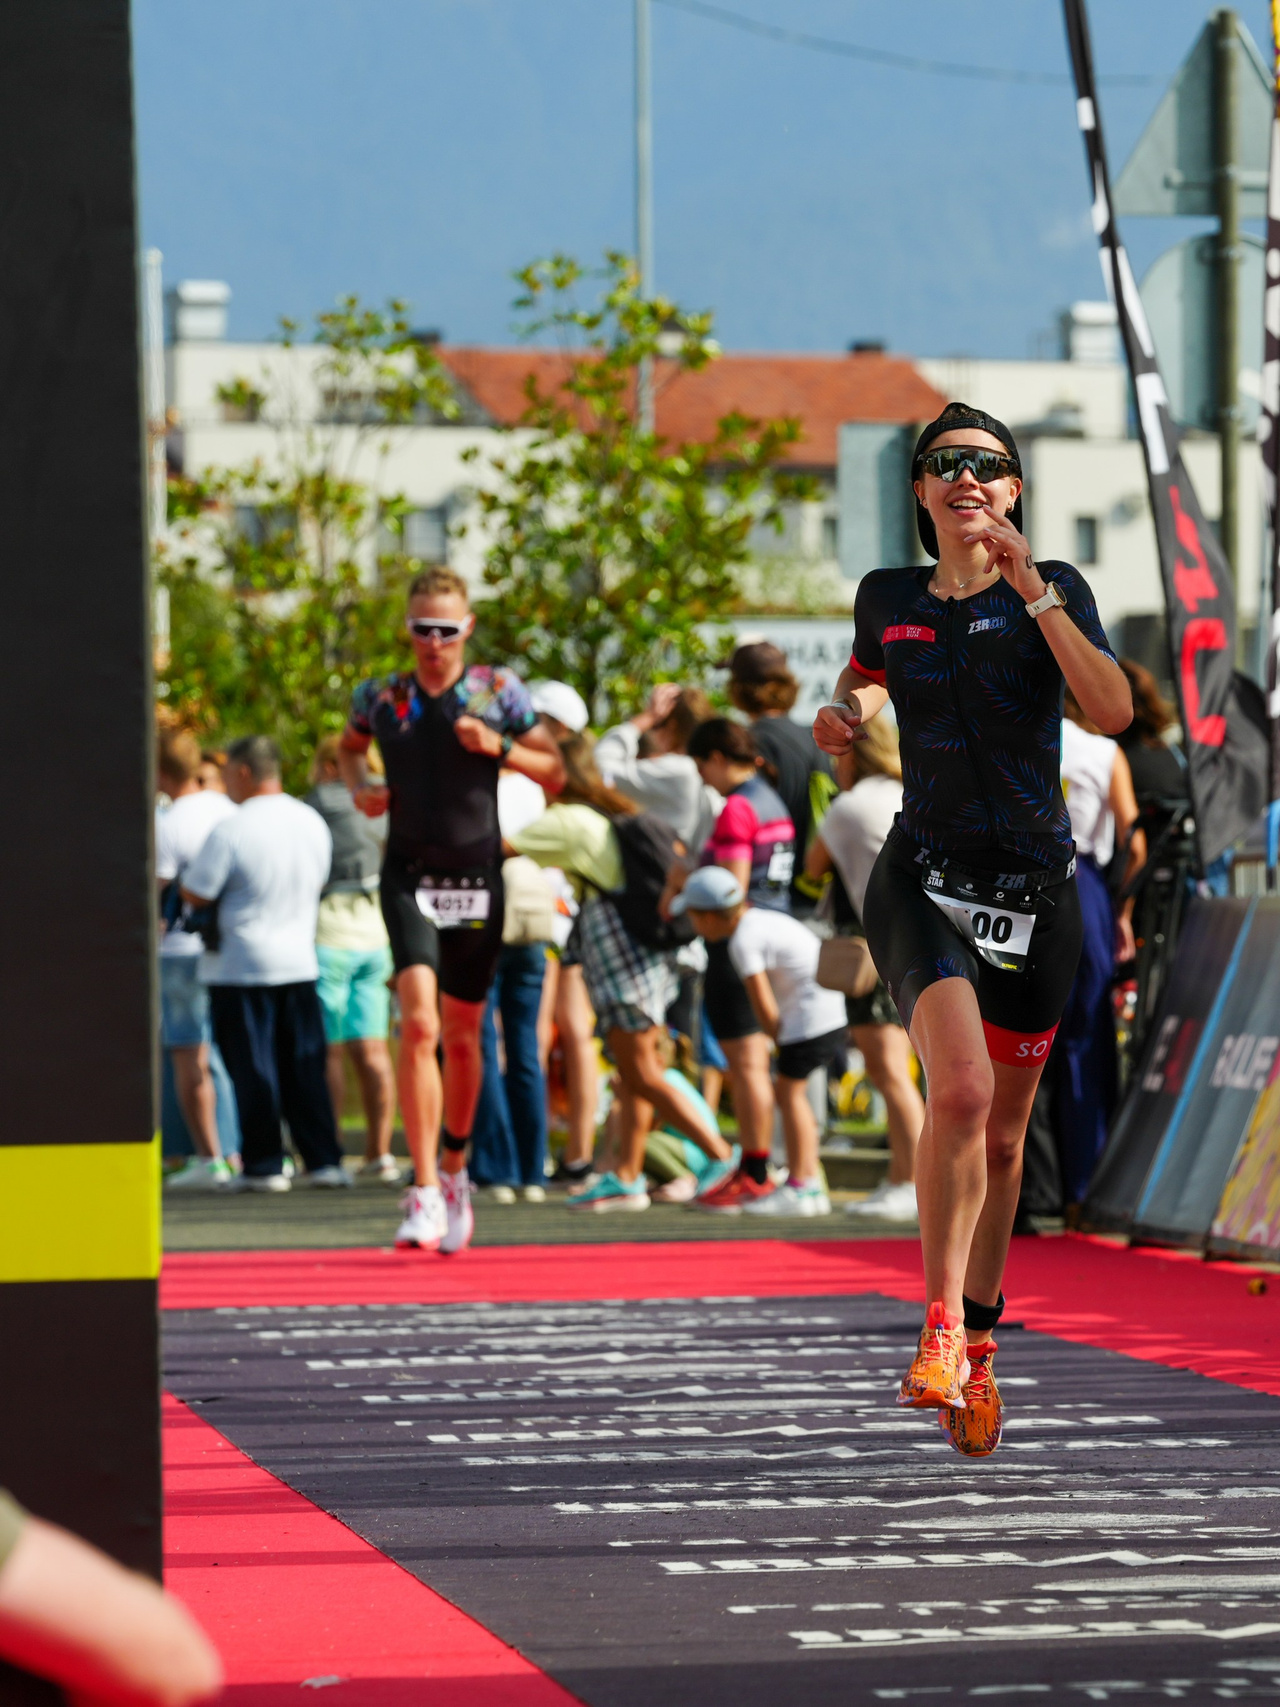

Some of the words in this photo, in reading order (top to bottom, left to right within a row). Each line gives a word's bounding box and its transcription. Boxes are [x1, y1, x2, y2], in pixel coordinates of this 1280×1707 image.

[927, 876, 944, 888] STAR
[551, 1495, 880, 1512] IRON
[656, 1551, 1027, 1572] IRON
[788, 1618, 1206, 1643] IRON
